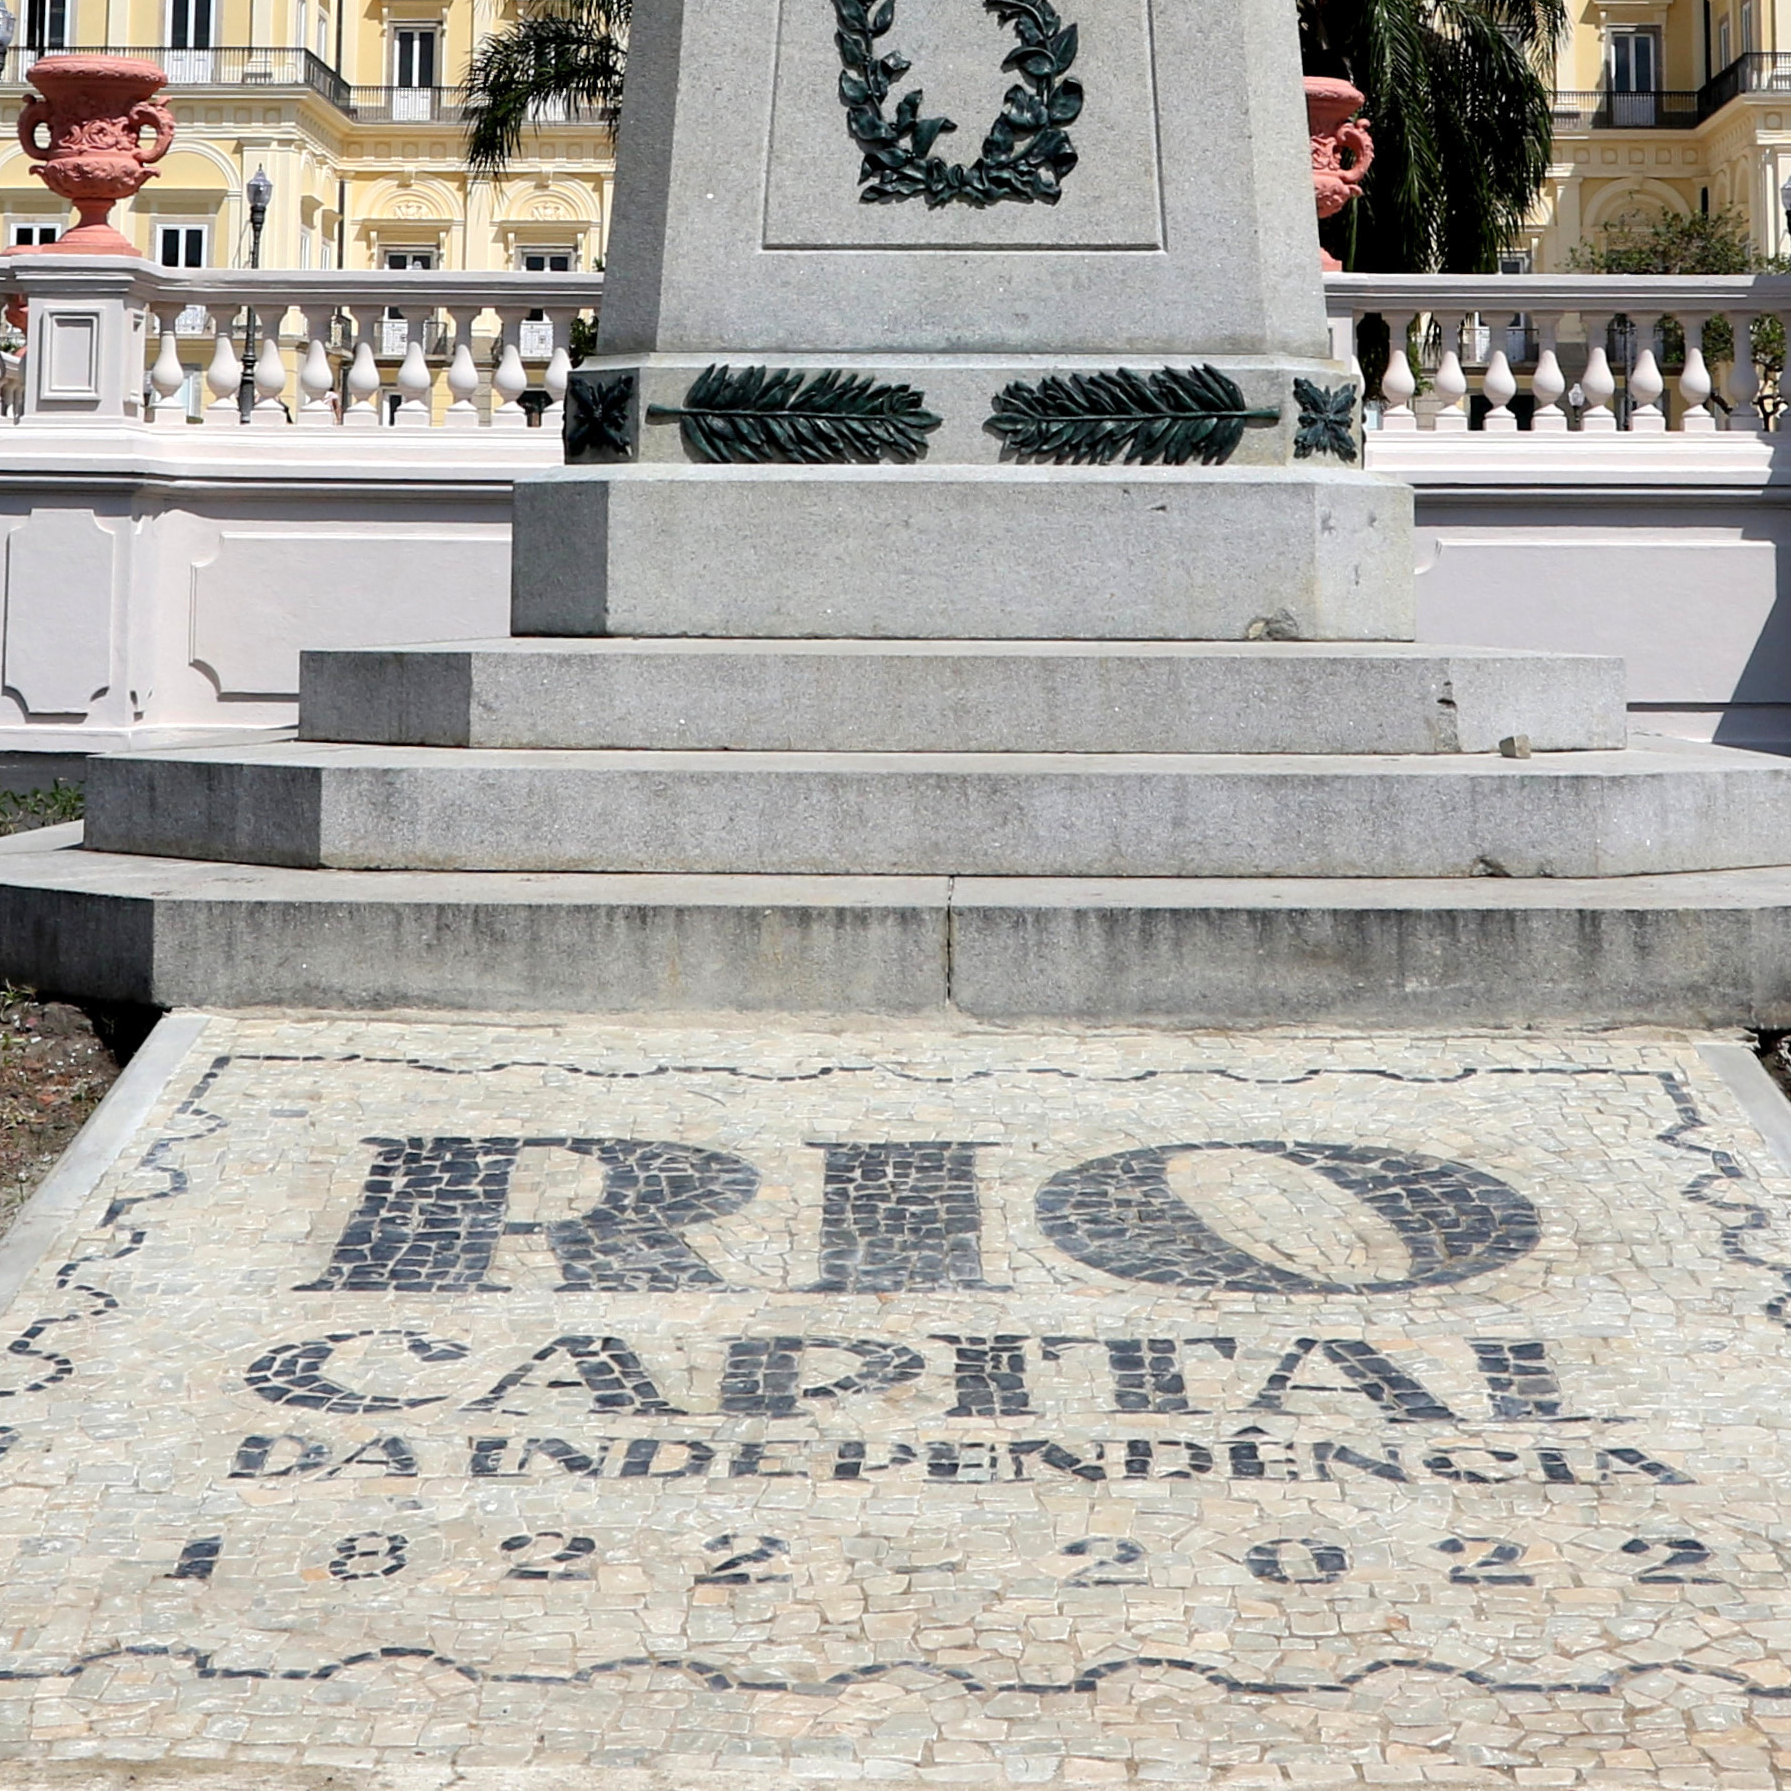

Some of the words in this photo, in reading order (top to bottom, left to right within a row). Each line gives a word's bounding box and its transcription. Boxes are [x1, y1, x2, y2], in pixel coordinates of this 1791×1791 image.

[291, 1136, 1541, 1295] RIO
[244, 1329, 1637, 1423] CAPITAL
[228, 1434, 418, 1479] DA
[467, 1426, 1699, 1485] INDEPENDÊNCIA
[163, 1531, 792, 1586] 1822
[1059, 1536, 1726, 1587] 2022
